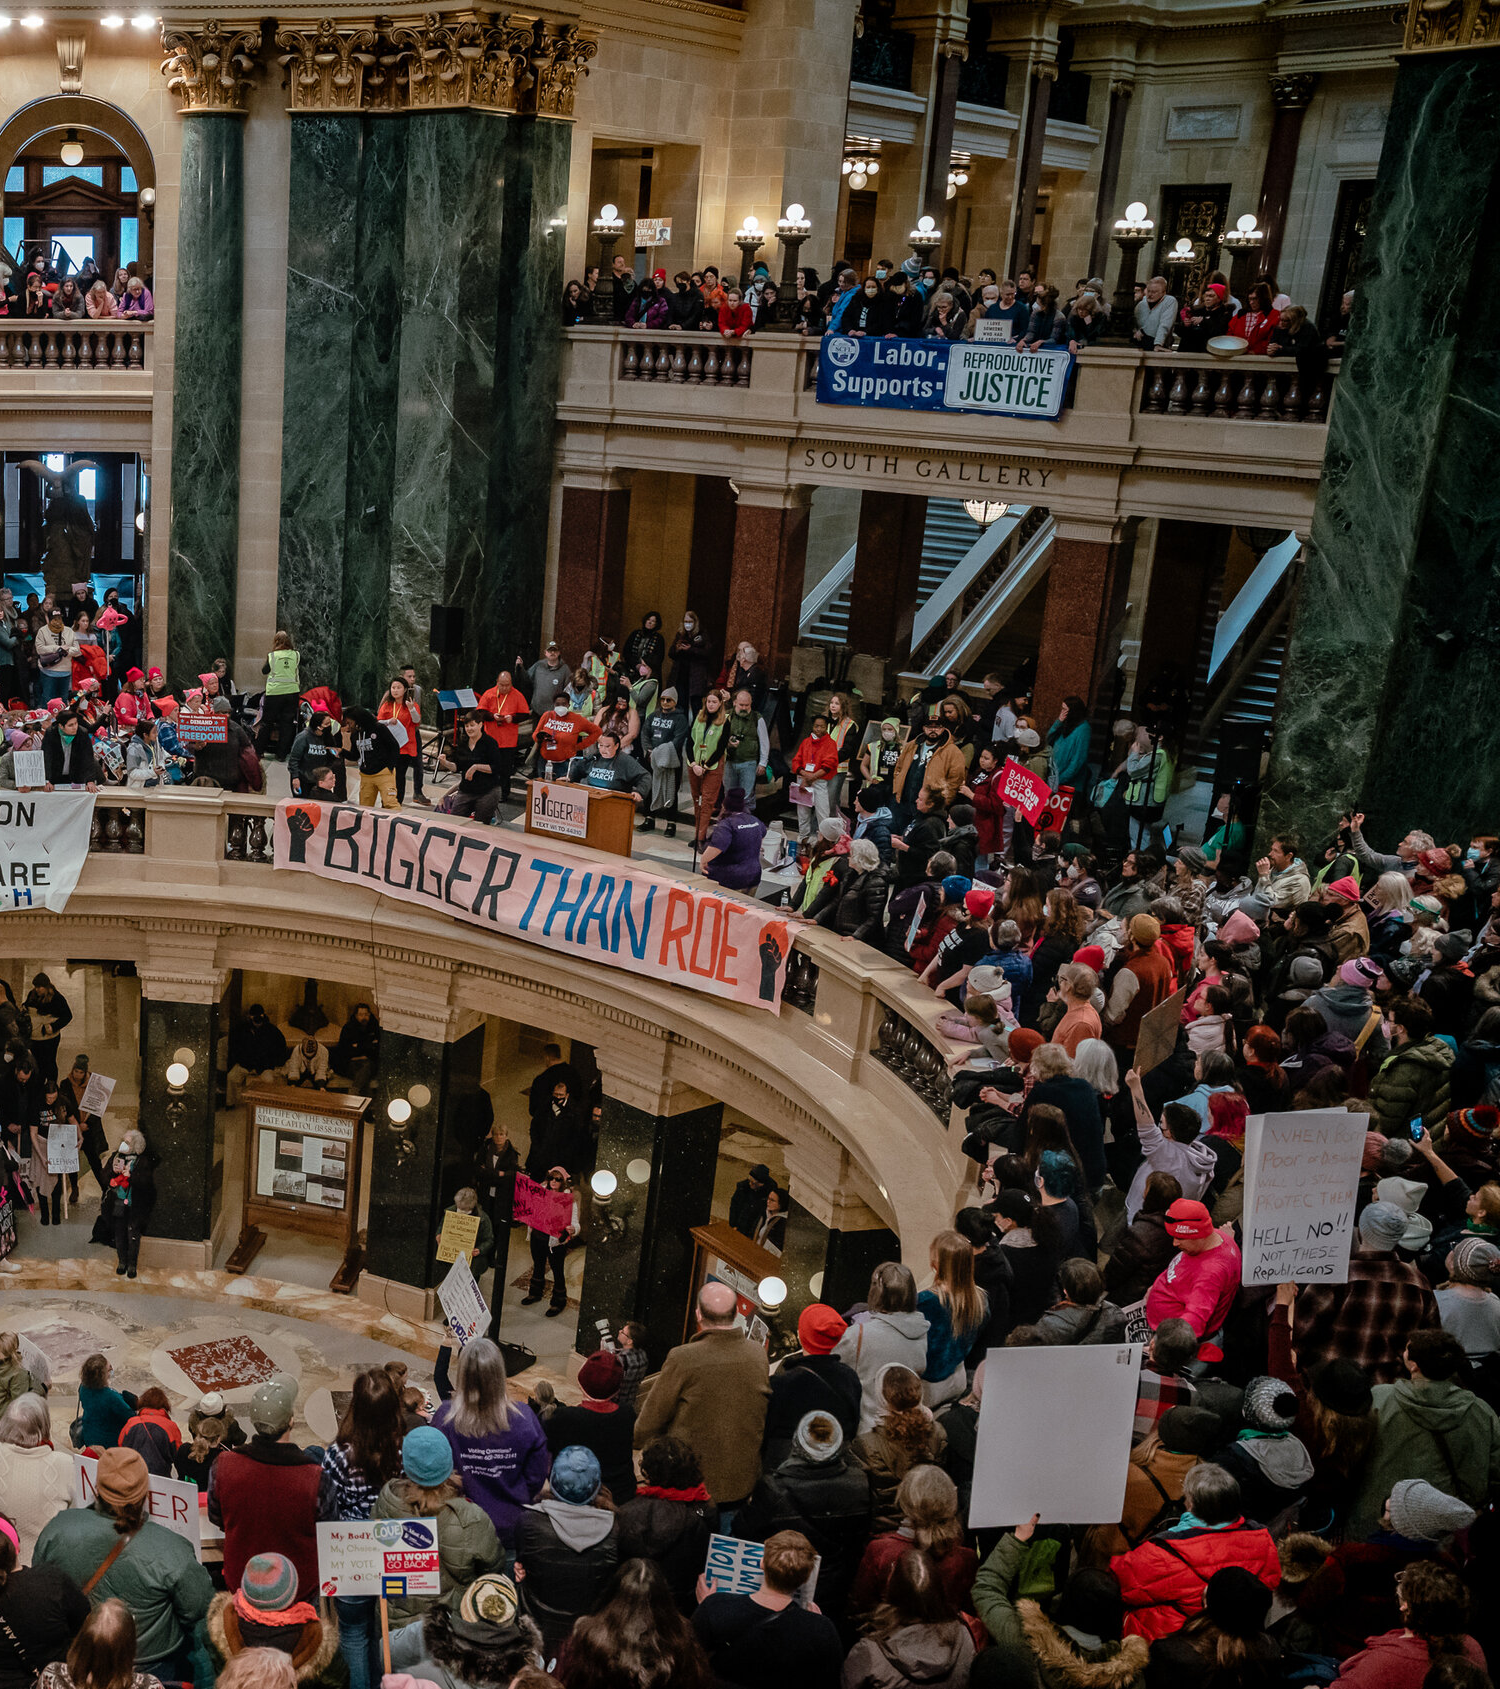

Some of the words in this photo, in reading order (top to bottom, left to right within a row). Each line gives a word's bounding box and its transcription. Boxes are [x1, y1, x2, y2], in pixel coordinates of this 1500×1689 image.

[963, 351, 1055, 376] REPRODUCTIVE
[959, 371, 1052, 408] JUSTICE
[804, 449, 899, 475] SOUTH
[916, 459, 1053, 488] GALLERY
[179, 731, 225, 741] FREEDOM!
[589, 771, 615, 781] MARCH
[1009, 769, 1033, 789] BANS
[1003, 785, 1034, 811] BODIES
[1006, 777, 1025, 791] OFF
[1024, 788, 1039, 807] OUR
[534, 797, 574, 821] BIGGER
[324, 806, 521, 922] BIGGER
[519, 858, 658, 960] THAN
[658, 887, 748, 985] ROE
[258, 1115, 279, 1124] STATE
[281, 1119, 312, 1131] CAPITOL
[315, 1124, 352, 1137] (1858-1904)
[305, 1114, 318, 1123] THE
[322, 1117, 353, 1127] SECOND
[1272, 1128, 1328, 1143] WHEN
[515, 1179, 528, 1192] MY
[1258, 1177, 1286, 1188] WILL
[1320, 1190, 1353, 1205] THEM
[513, 1200, 526, 1211] MY
[1253, 1226, 1298, 1247] HELL
[1261, 1250, 1286, 1263] NOT
[1292, 1246, 1340, 1260] THESE
[1253, 1263, 1335, 1281] Republicans
[467, 1447, 485, 1455] Voting
[375, 1526, 401, 1538] LOVE
[386, 1553, 402, 1562] WE
[404, 1552, 439, 1560] WON'T
[387, 1561, 402, 1569] GO
[404, 1560, 430, 1569] BACK.
[331, 1561, 345, 1569] MY
